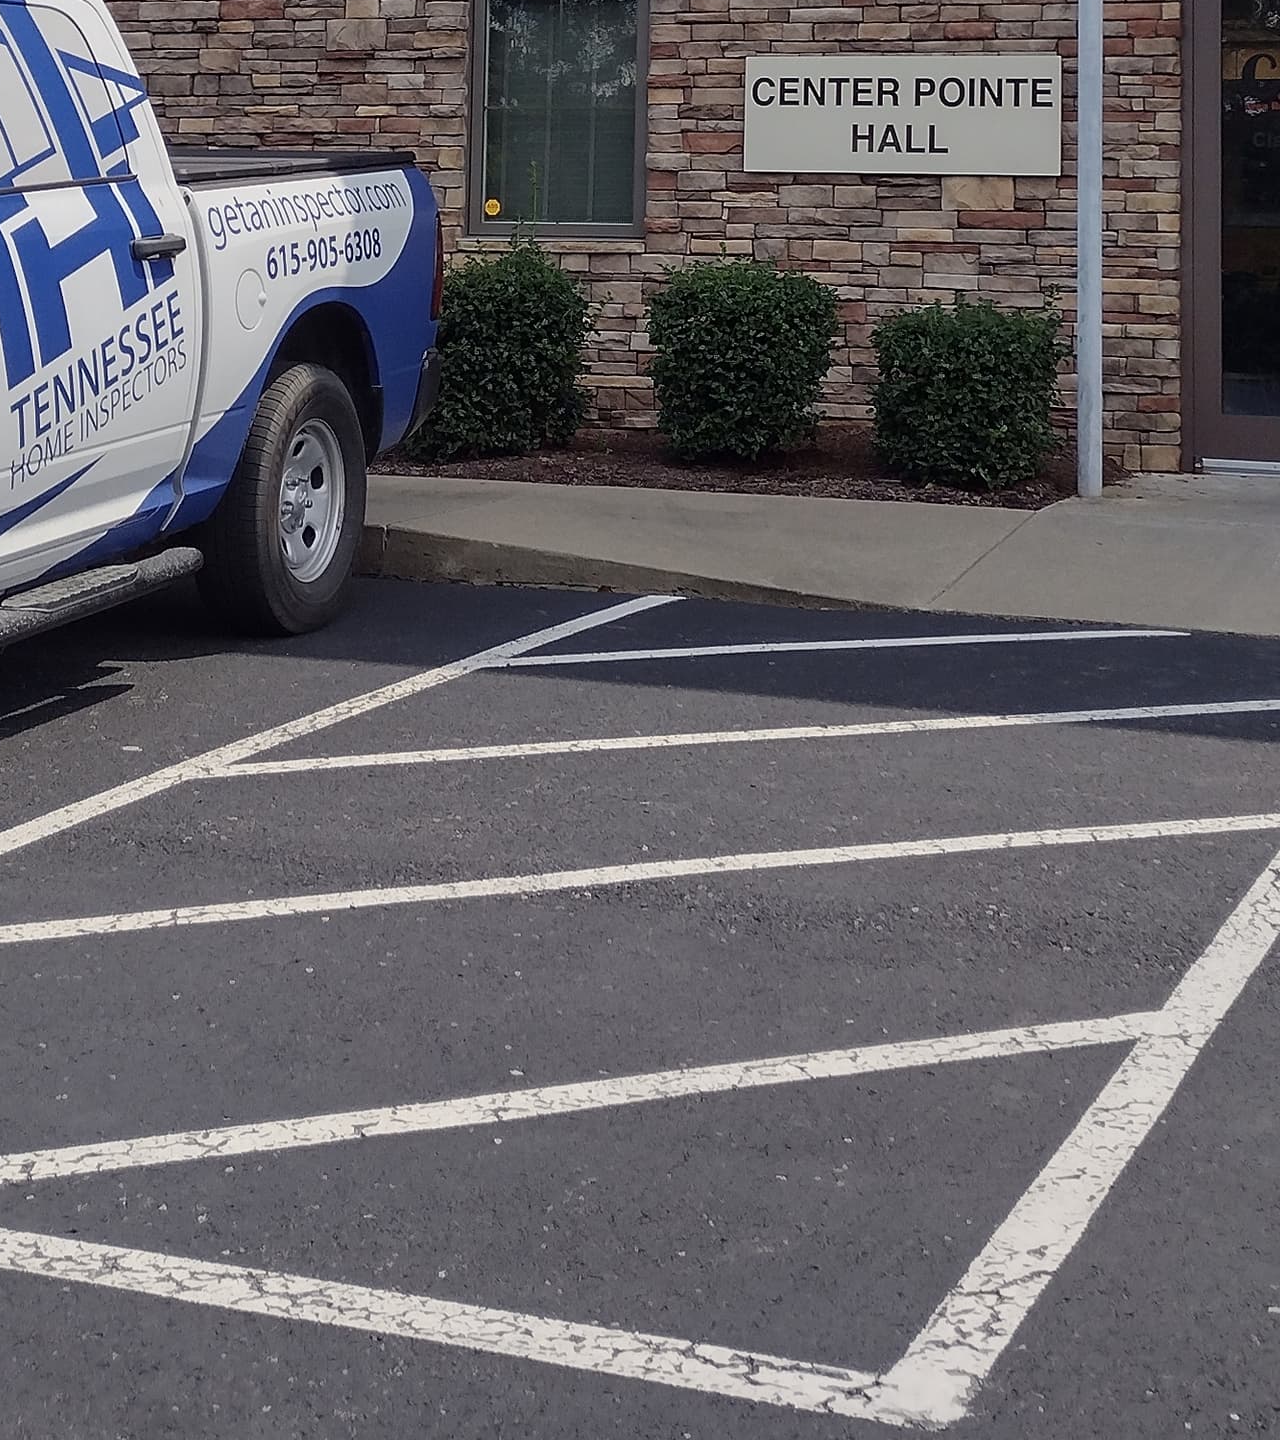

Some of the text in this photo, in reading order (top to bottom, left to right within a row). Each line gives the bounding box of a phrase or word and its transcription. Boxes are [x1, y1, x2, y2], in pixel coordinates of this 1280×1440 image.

[751, 77, 1054, 108] CENTER POINTE
[851, 123, 950, 154] HALL
[207, 180, 407, 251] getaninspector.com
[266, 228, 382, 280] 615-905-6308
[10, 290, 184, 449] TENNESSEE
[10, 339, 187, 490] HOME INSPECTORS
